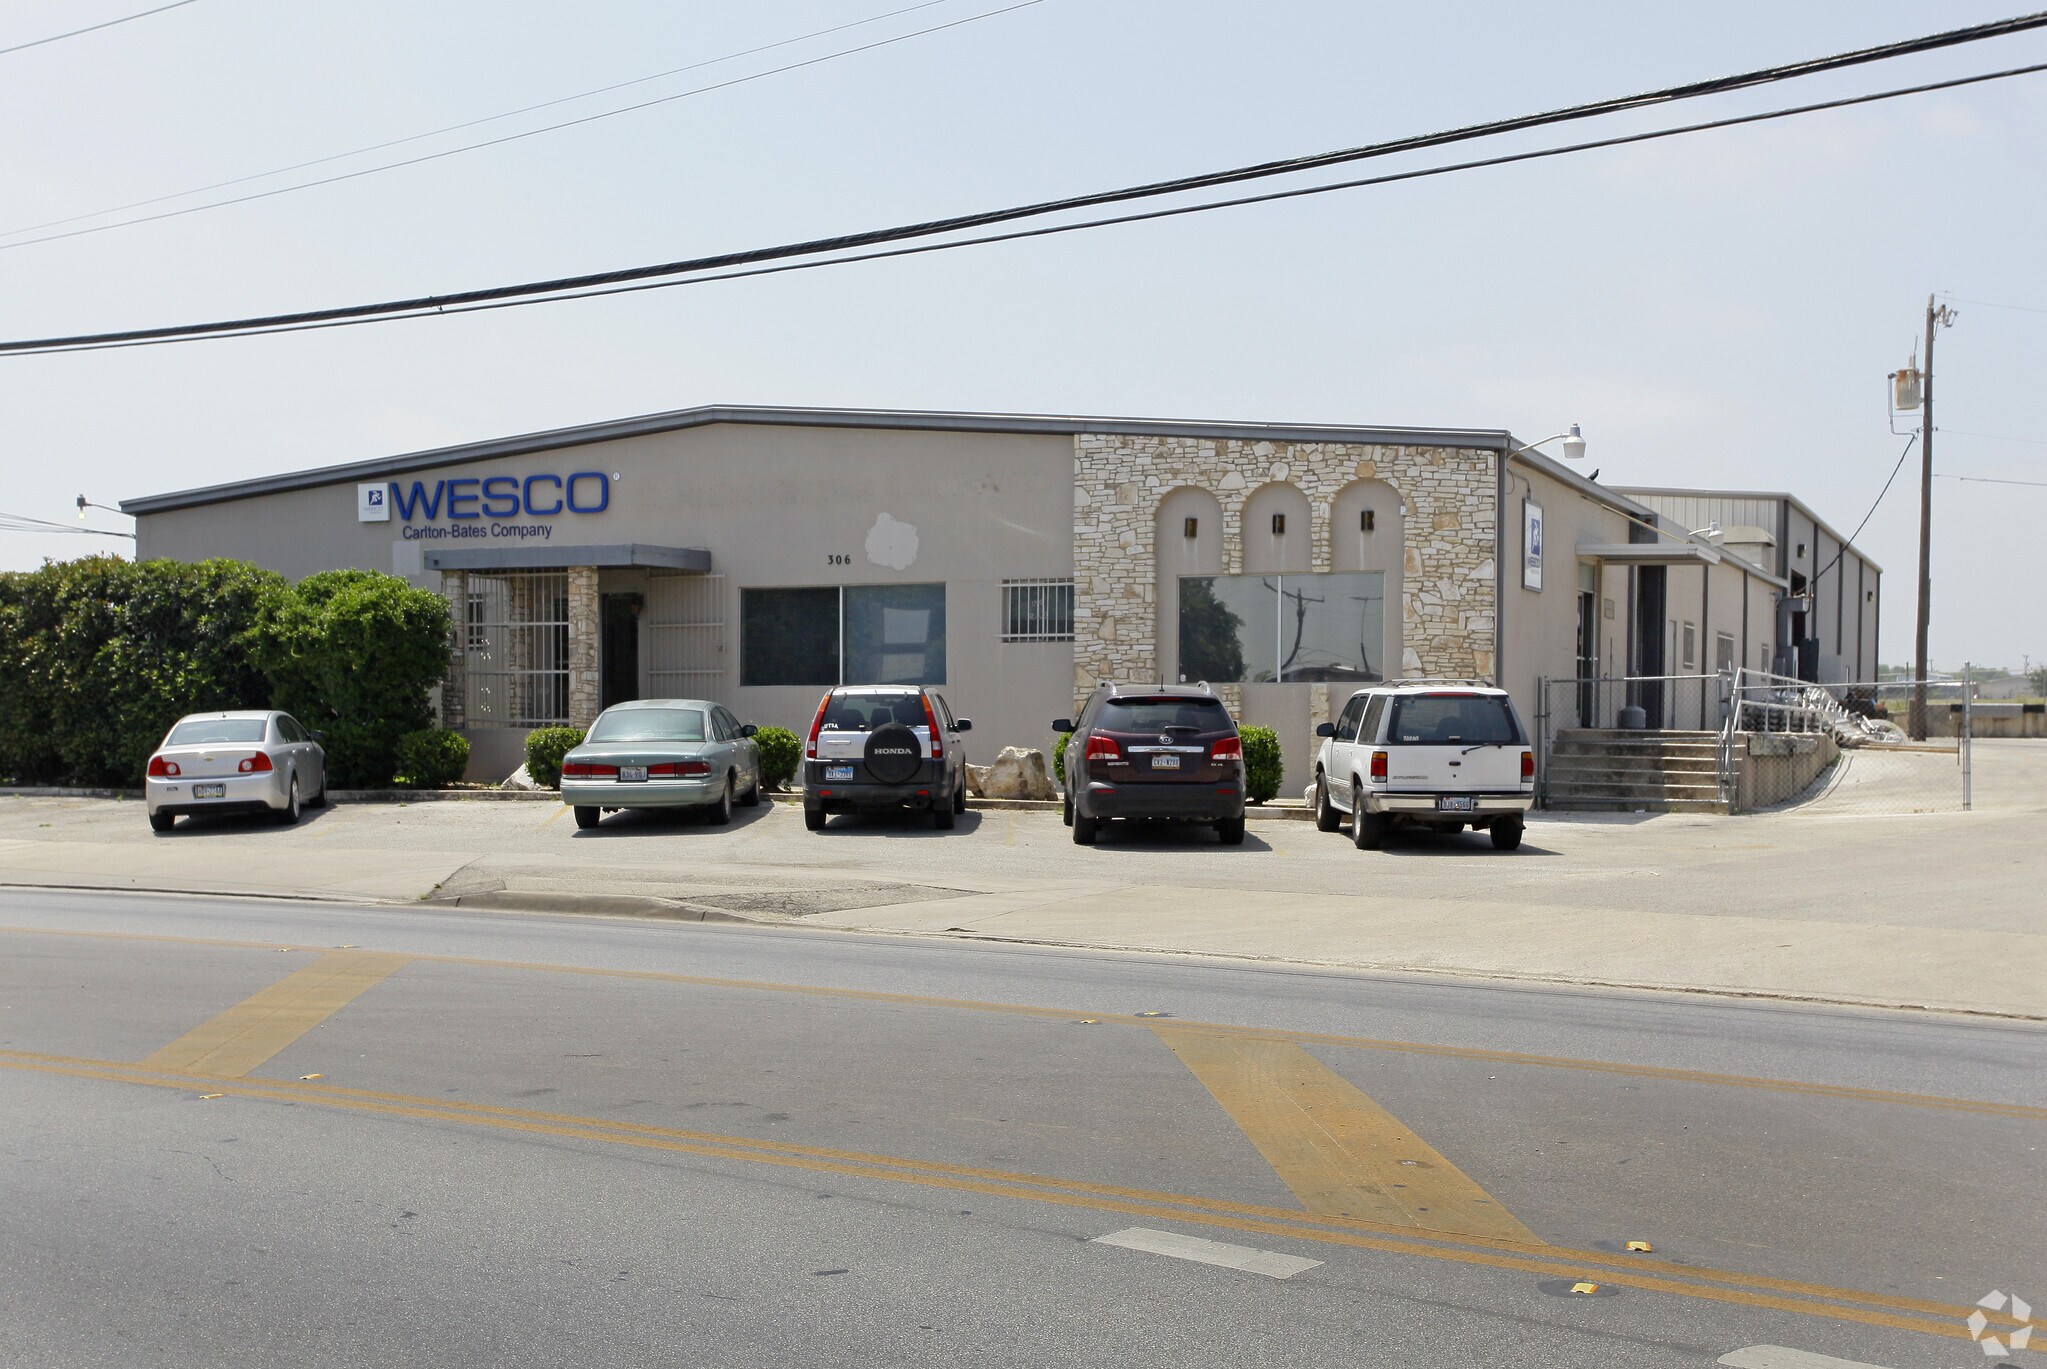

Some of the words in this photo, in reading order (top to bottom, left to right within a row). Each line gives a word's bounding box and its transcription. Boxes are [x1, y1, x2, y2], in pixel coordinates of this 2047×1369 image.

[390, 472, 609, 521] WESCO
[402, 524, 487, 540] Carlton-Bates
[490, 523, 552, 539] Company
[827, 554, 851, 565] 306
